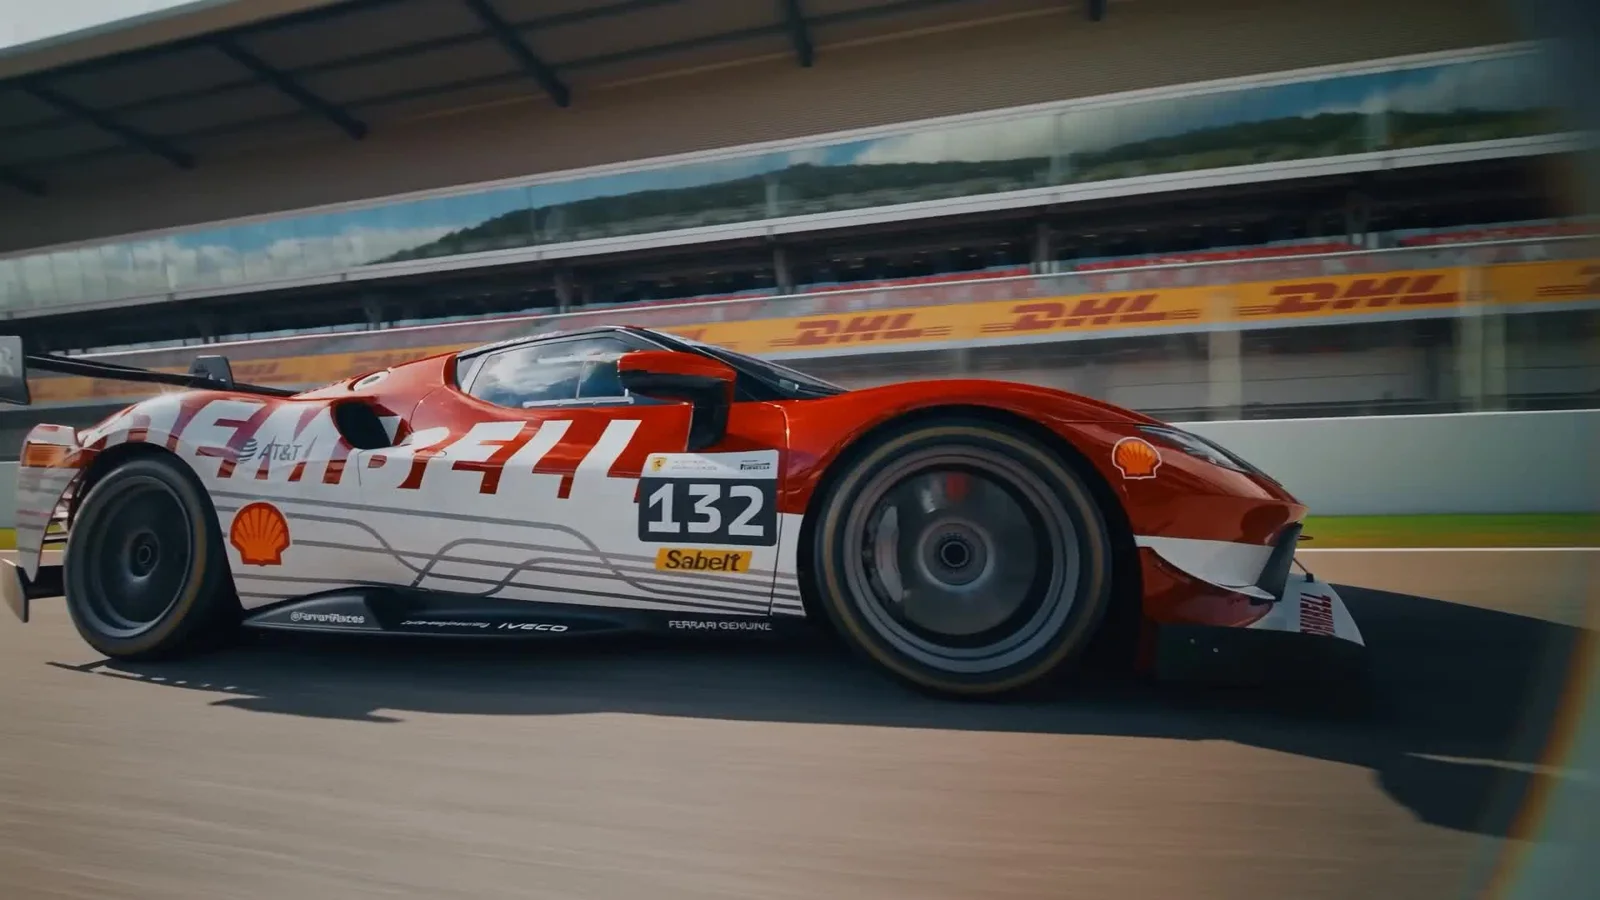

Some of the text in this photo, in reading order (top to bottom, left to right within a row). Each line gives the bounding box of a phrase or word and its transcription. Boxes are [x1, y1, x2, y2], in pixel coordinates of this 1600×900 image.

[1269, 274, 1459, 314] DHL
[1012, 292, 1167, 331] DHL
[794, 312, 923, 346] DHL
[258, 440, 302, 461] AT&T
[648, 483, 764, 537] 132
[665, 550, 740, 572] Sabelt
[498, 622, 568, 632] IVECO
[668, 620, 717, 630] FERRARI
